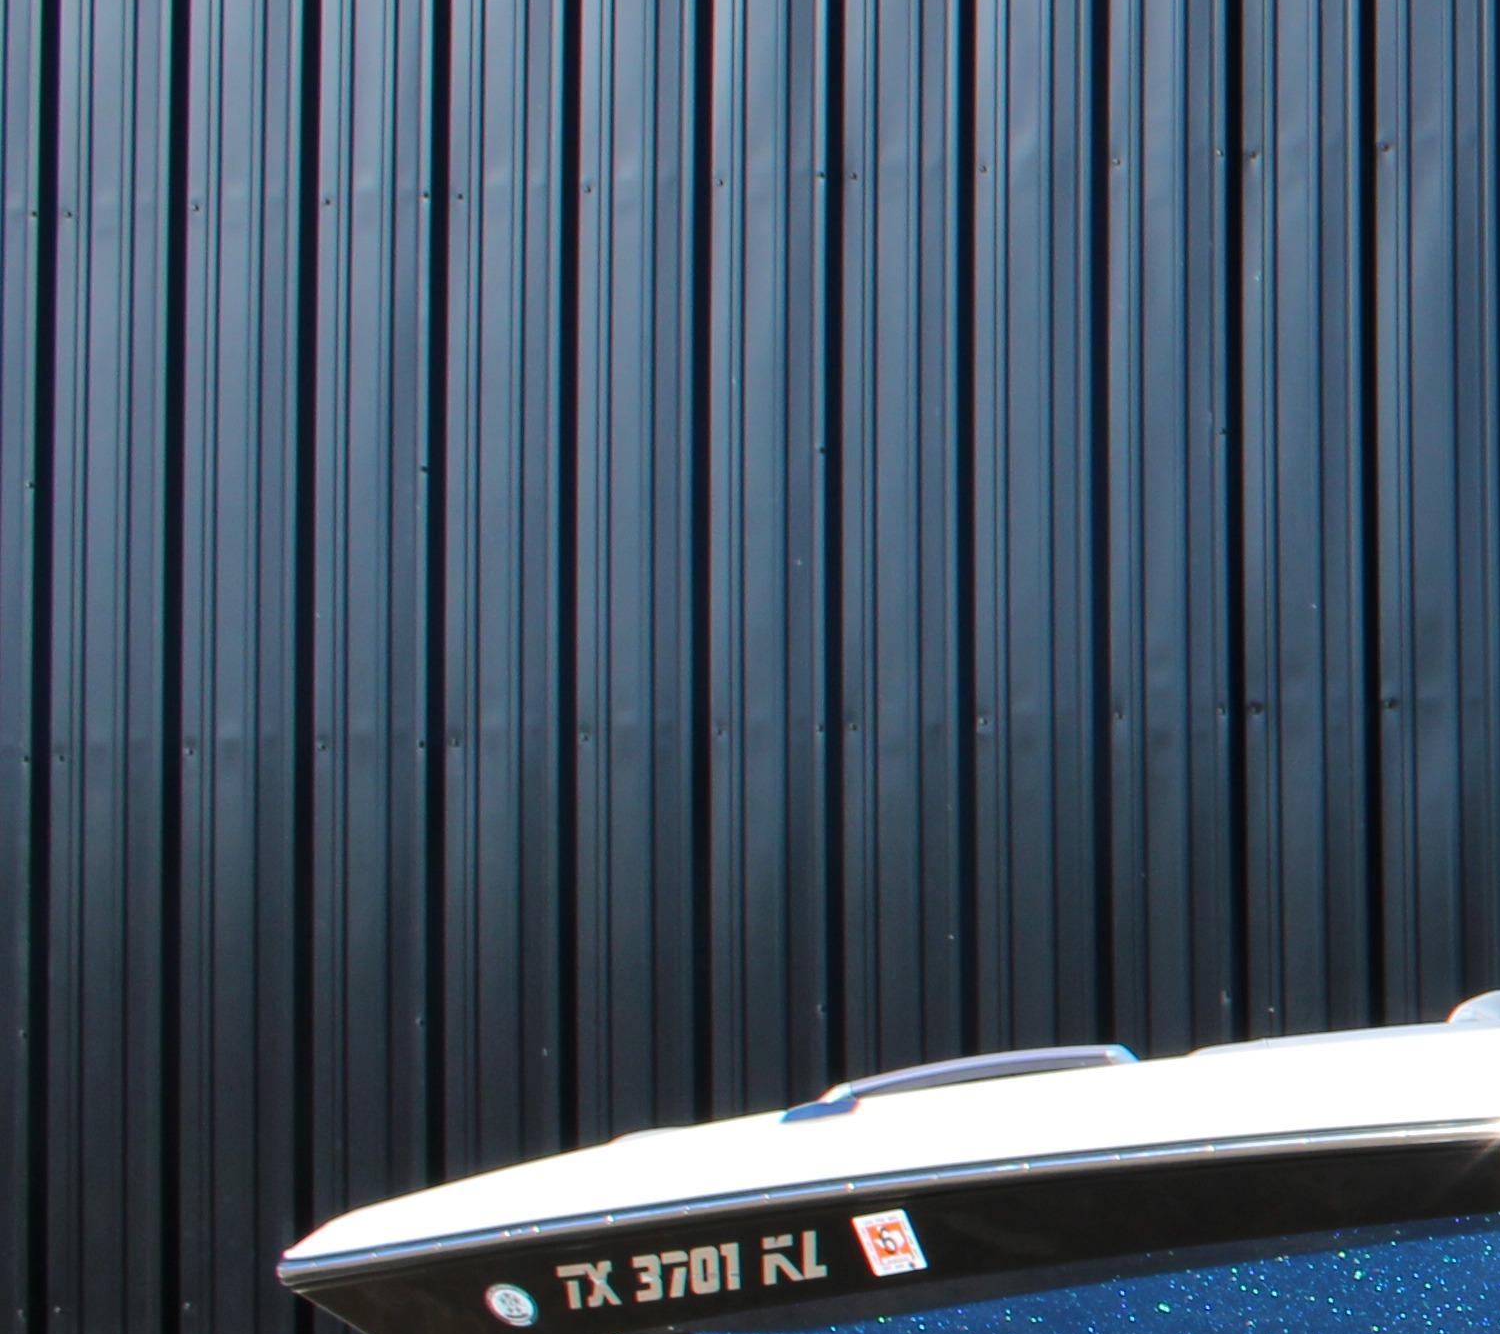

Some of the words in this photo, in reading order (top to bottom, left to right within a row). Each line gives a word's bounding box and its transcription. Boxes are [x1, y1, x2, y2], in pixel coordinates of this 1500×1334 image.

[555, 1259, 623, 1310] TX
[630, 1241, 742, 1303] 3701
[760, 1229, 829, 1286] KL
